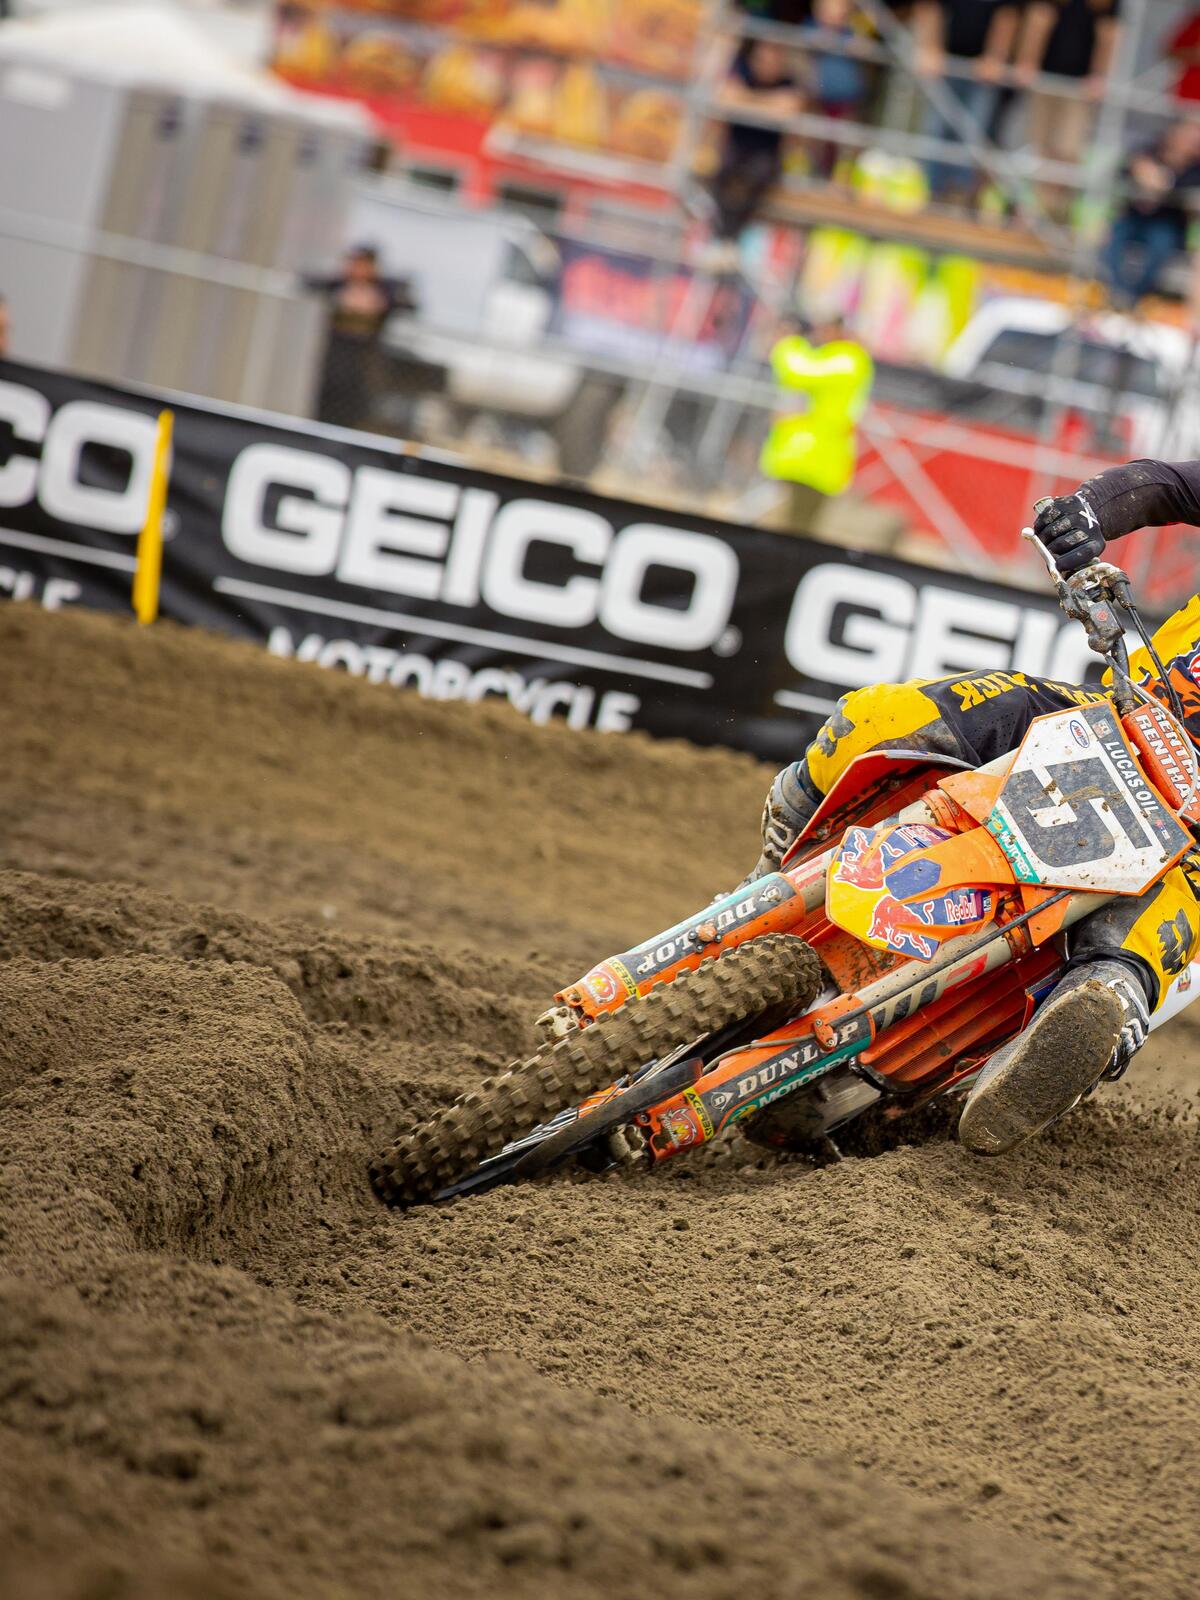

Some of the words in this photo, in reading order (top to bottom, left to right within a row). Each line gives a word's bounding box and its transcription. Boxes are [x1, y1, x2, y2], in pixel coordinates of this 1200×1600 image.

[220, 441, 740, 652] GEICO
[1000, 756, 1152, 868] 5
[1104, 740, 1145, 794] LUCAS
[1134, 790, 1160, 817] OIL
[735, 1020, 859, 1098] DUNLP
